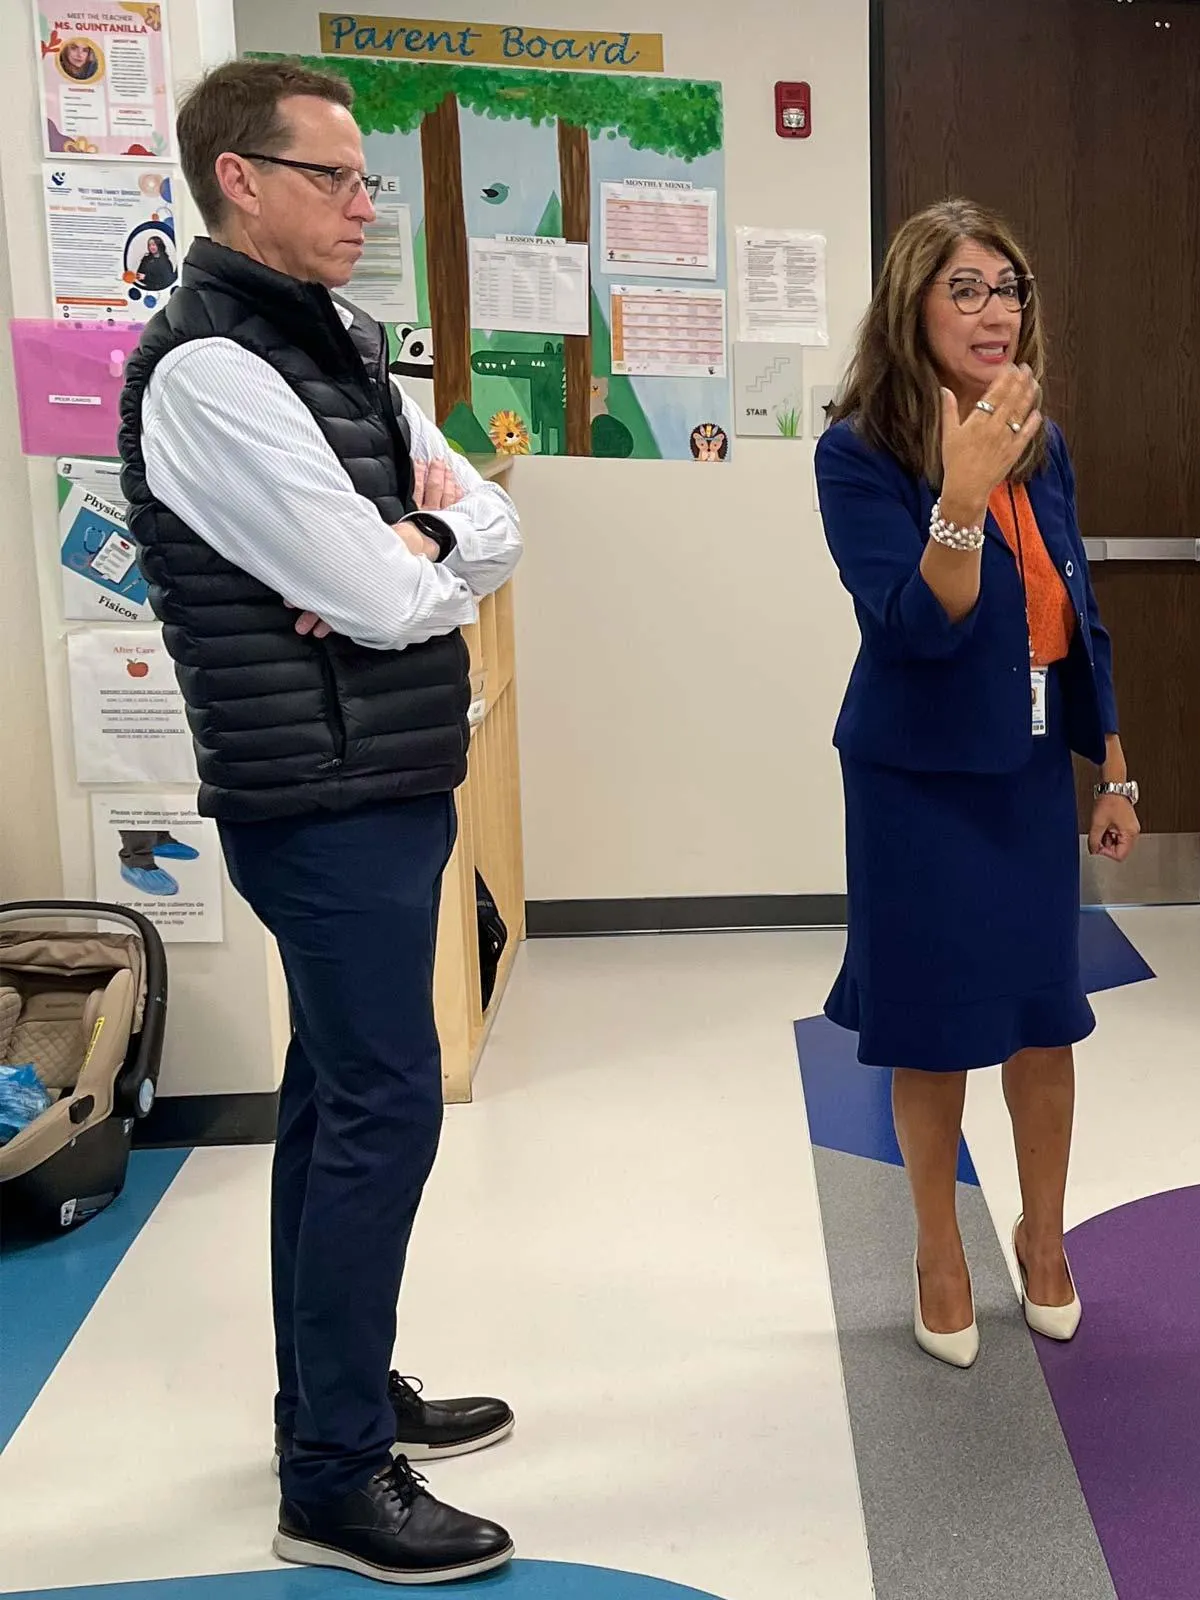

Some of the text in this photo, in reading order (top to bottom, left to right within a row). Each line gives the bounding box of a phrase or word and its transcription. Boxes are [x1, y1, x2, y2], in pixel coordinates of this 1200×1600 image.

[54, 21, 148, 33] MS. QUINTANILLA
[330, 16, 640, 66] Parent Board
[84, 493, 126, 522] Physica
